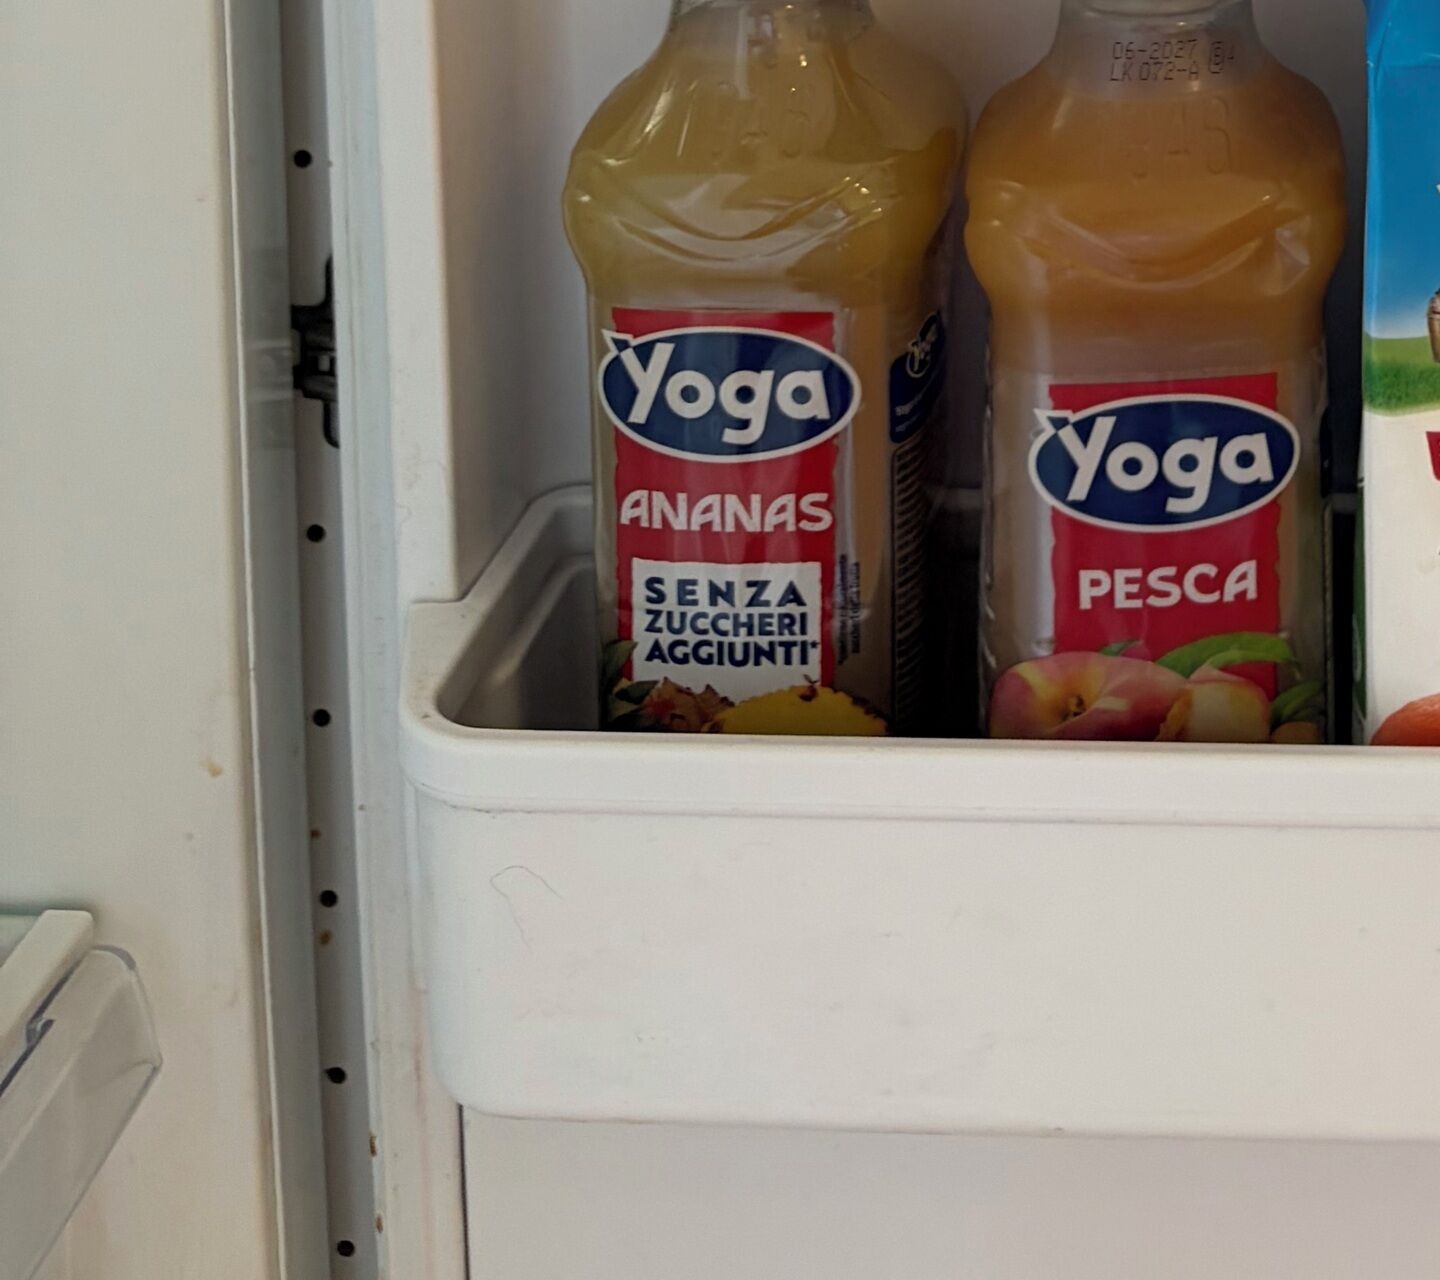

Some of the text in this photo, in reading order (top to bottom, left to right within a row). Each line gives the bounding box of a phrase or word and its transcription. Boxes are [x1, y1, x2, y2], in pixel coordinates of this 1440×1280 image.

[608, 332, 832, 444] Yoga
[1037, 410, 1274, 513] Yoga
[620, 489, 833, 532] ANANAS
[645, 577, 807, 608] SENZA
[1079, 560, 1257, 610] PESCA
[645, 609, 808, 638] ZUCCHERI
